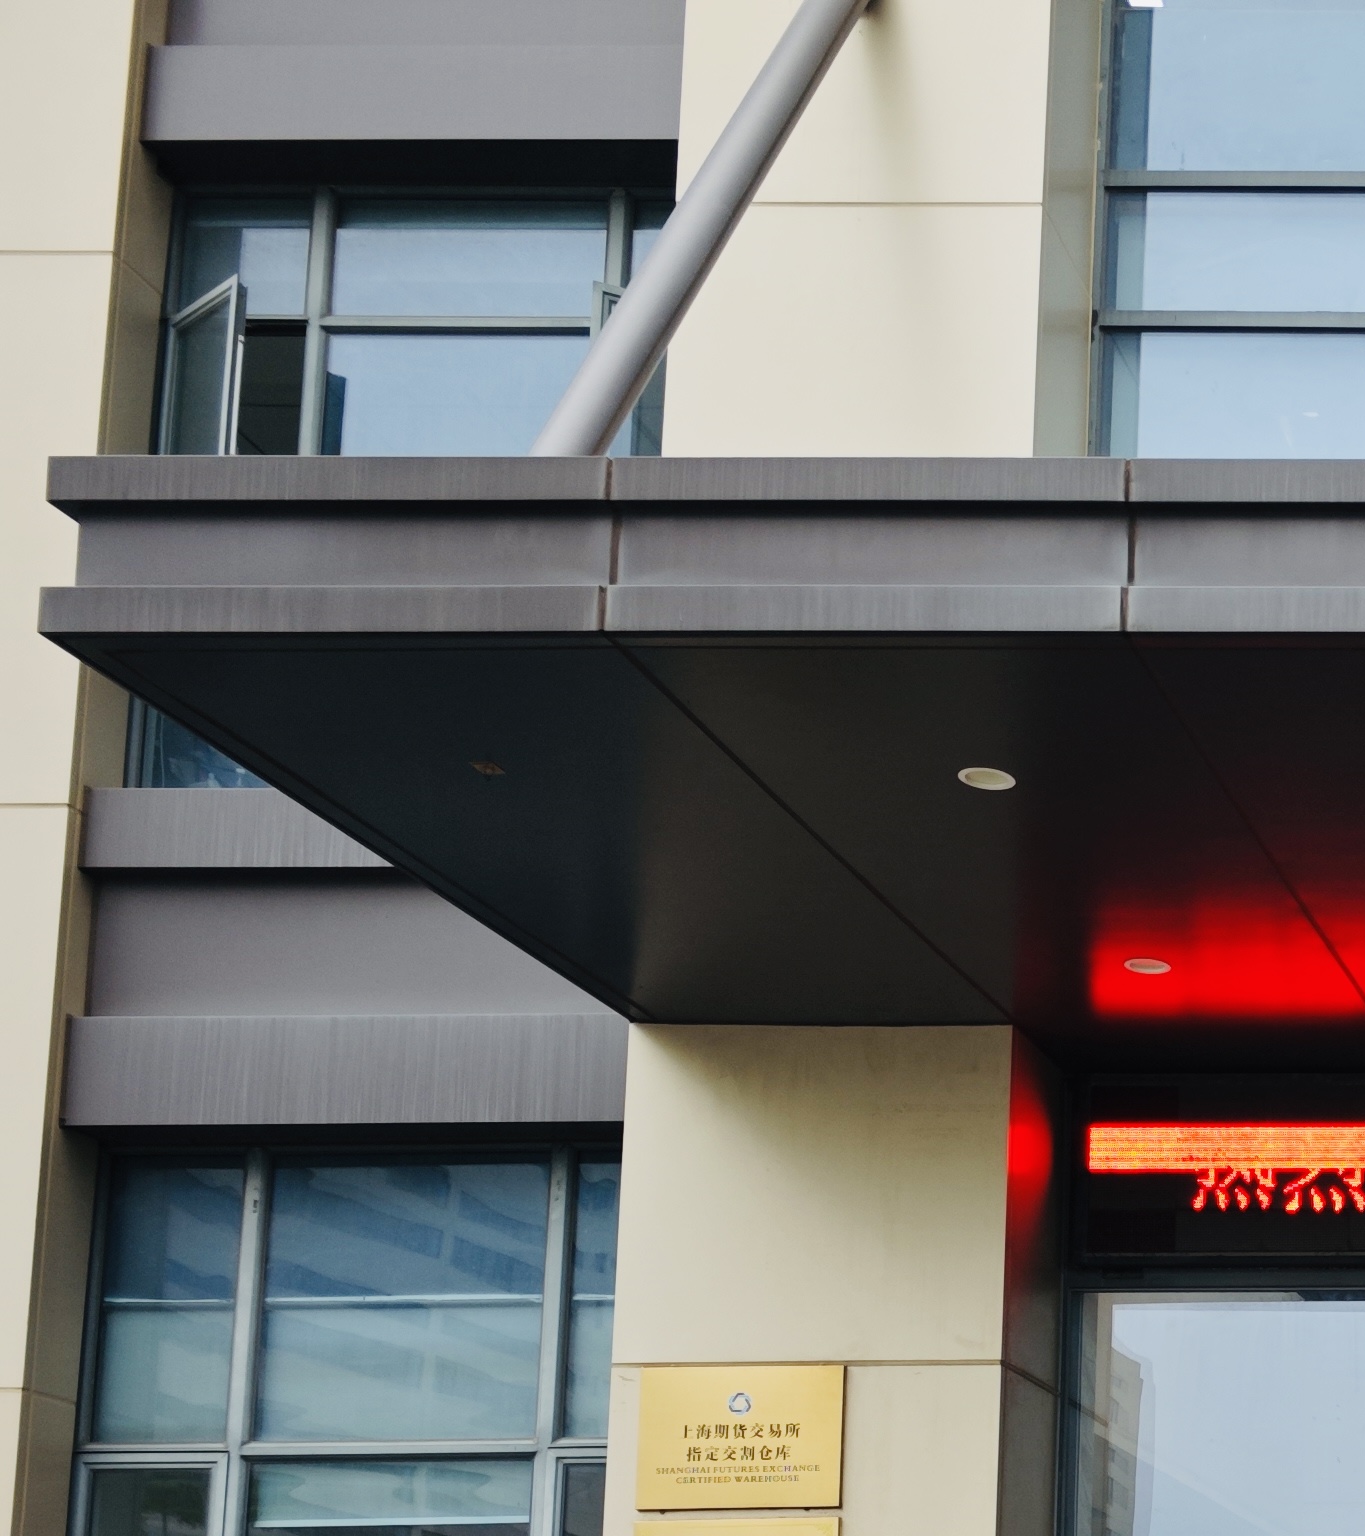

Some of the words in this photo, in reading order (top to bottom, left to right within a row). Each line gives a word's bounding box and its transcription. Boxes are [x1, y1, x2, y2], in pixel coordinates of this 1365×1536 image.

[683, 1423, 800, 1440] 上海期货交易所
[686, 1444, 792, 1462] 指定交割仓库
[655, 1466, 710, 1474] SHANGHAI
[713, 1465, 760, 1473] FUTURES
[762, 1464, 820, 1472] EXCHANGE
[676, 1476, 731, 1484] CERTIFIED
[734, 1475, 800, 1483] WAREHOUSE
